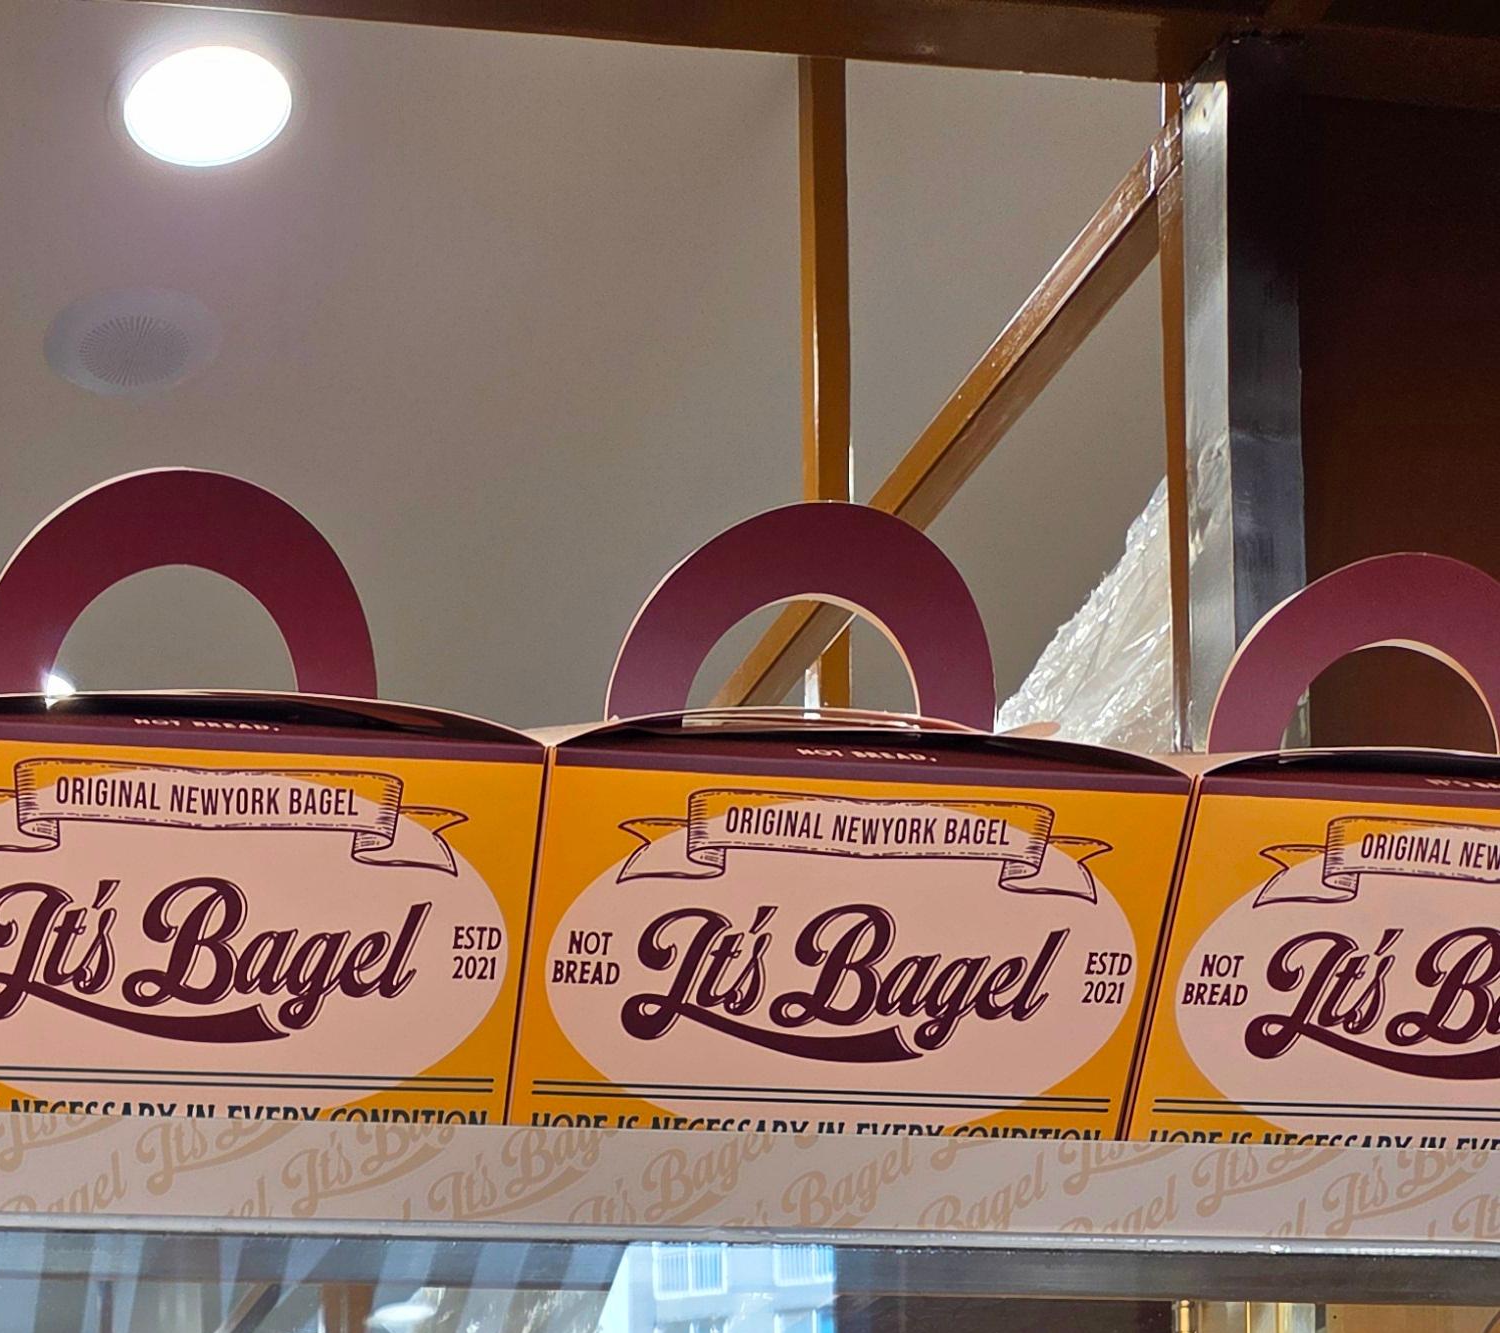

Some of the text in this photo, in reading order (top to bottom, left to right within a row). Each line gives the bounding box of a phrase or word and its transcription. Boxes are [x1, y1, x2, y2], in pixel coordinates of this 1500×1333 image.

[55, 776, 360, 818] ORIGINAL NEWYORK BAGEL
[725, 806, 1011, 847] ORIGINAL NEWYORK BAGEL
[1360, 833, 1452, 866] ORIGINAL
[452, 925, 502, 952] ESTD
[567, 930, 614, 956] NOT
[122, 876, 433, 1030] Bagel
[1084, 951, 1133, 977] ESTD
[1200, 953, 1245, 979] NOT
[452, 954, 498, 982] 2021
[551, 958, 621, 986] BREAD
[619, 904, 1071, 1050] It's Bagel
[1081, 980, 1125, 1005] 2021
[1181, 981, 1249, 1008] BREAD
[1244, 927, 1405, 1061] It's
